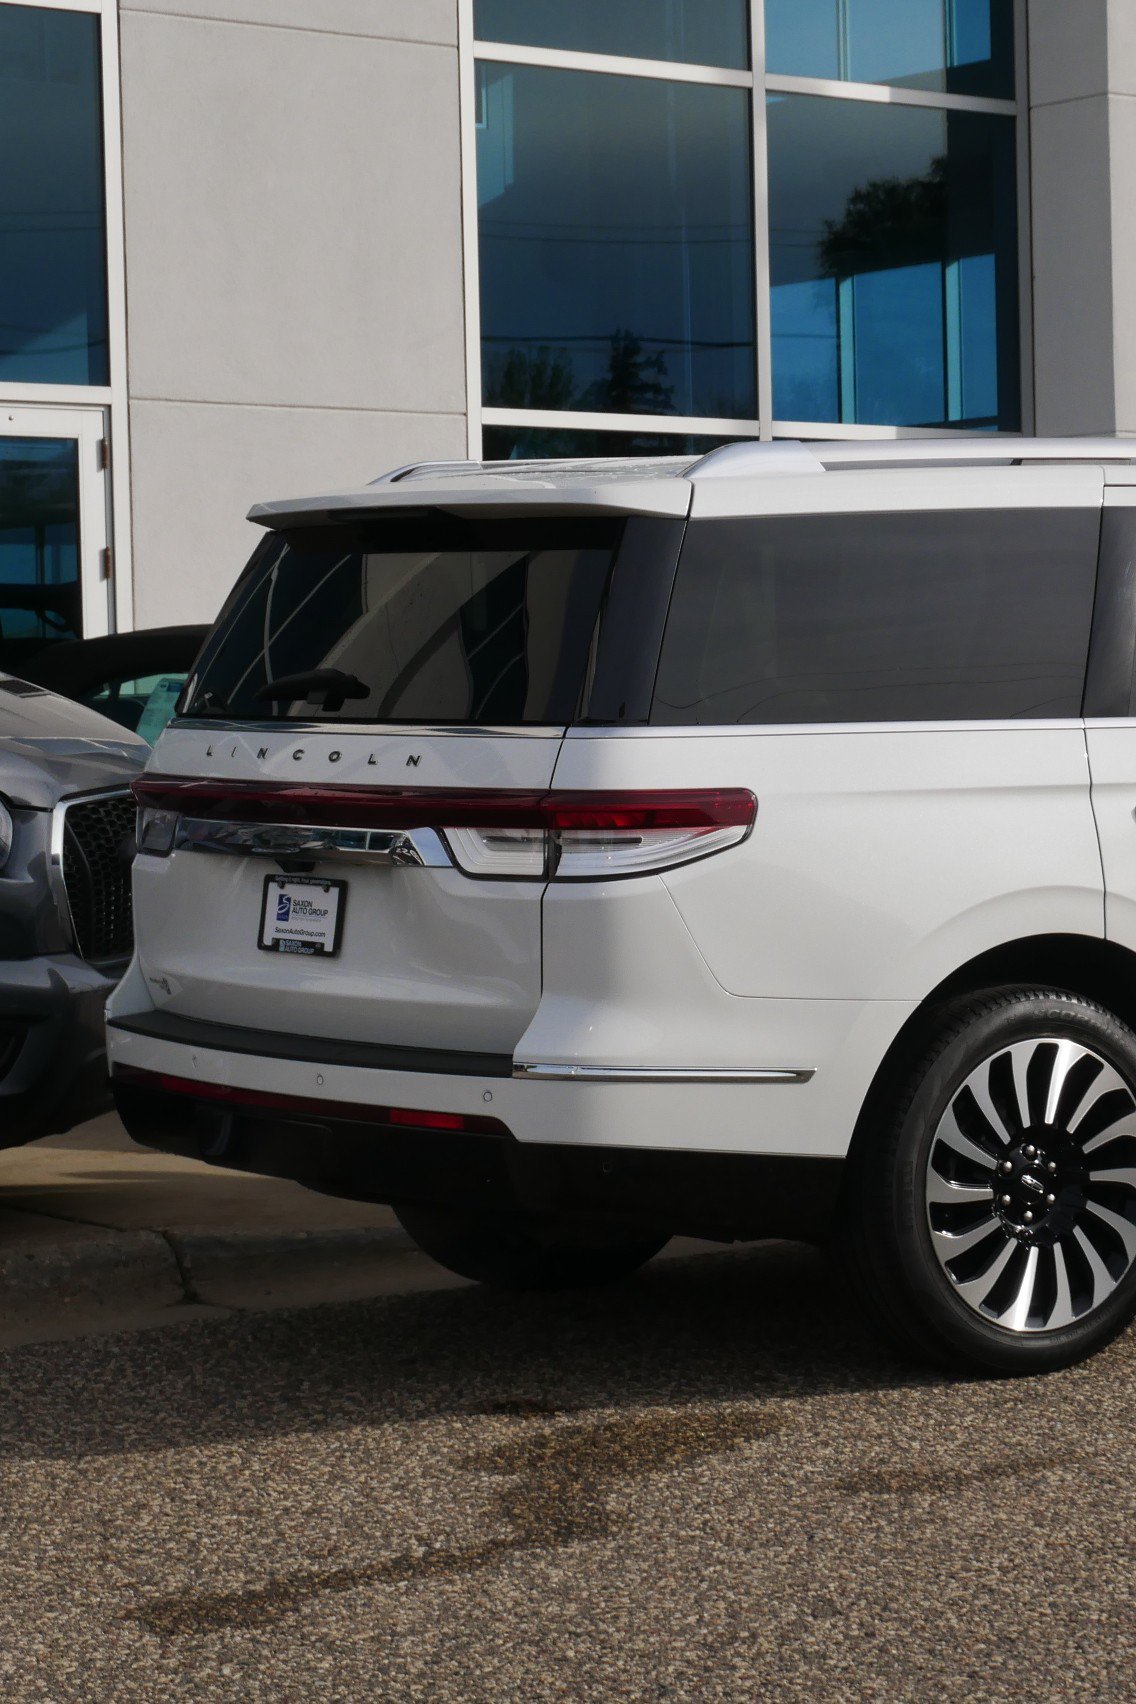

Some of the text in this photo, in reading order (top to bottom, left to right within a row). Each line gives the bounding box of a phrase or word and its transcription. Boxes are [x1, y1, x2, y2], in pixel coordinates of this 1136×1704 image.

[205, 745, 421, 767] LINCOLN
[293, 900, 313, 908] SAXON
[292, 907, 329, 916] AUTO GROUP
[275, 926, 326, 937] SaxonAutoGroup.com
[297, 946, 315, 954] GROUP
